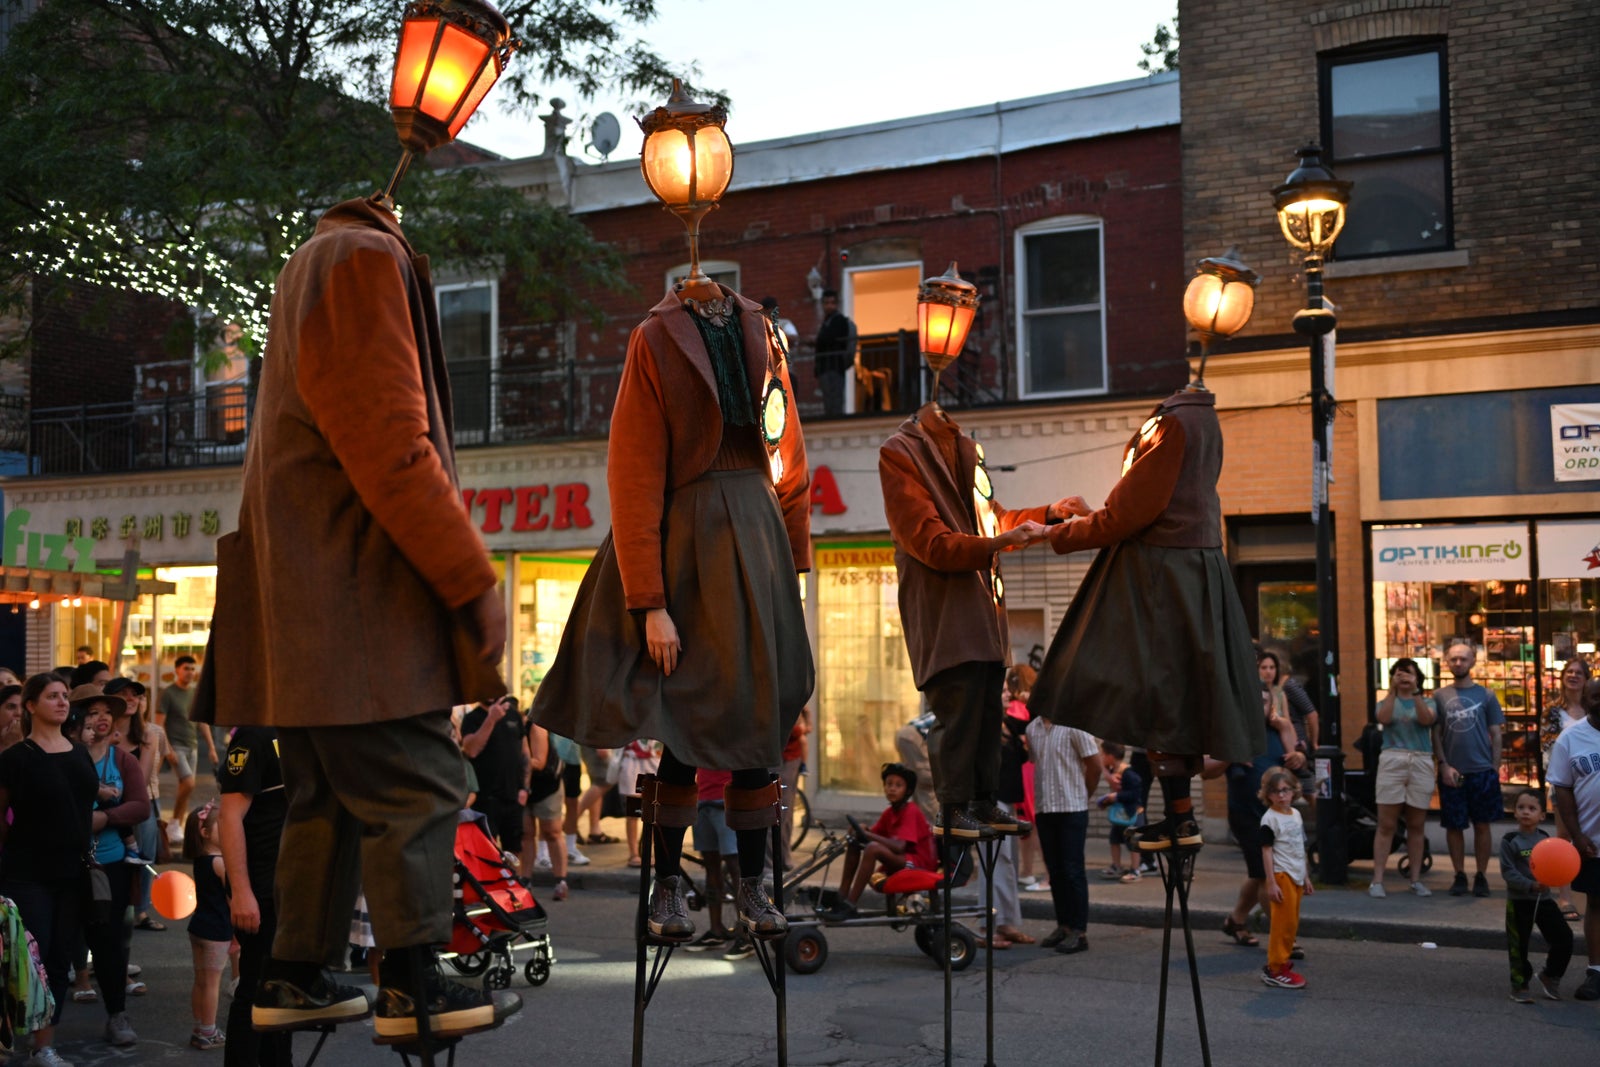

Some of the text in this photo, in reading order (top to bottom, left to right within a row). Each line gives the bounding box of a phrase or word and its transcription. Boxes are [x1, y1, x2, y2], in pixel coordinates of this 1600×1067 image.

[1564, 446, 1600, 454] VENT
[1565, 457, 1600, 469] ORD
[2, 508, 97, 573] fizz
[1379, 540, 1522, 563] OPTIKINFO
[1397, 558, 1430, 566] VENTES
[830, 570, 897, 587] 768-988
